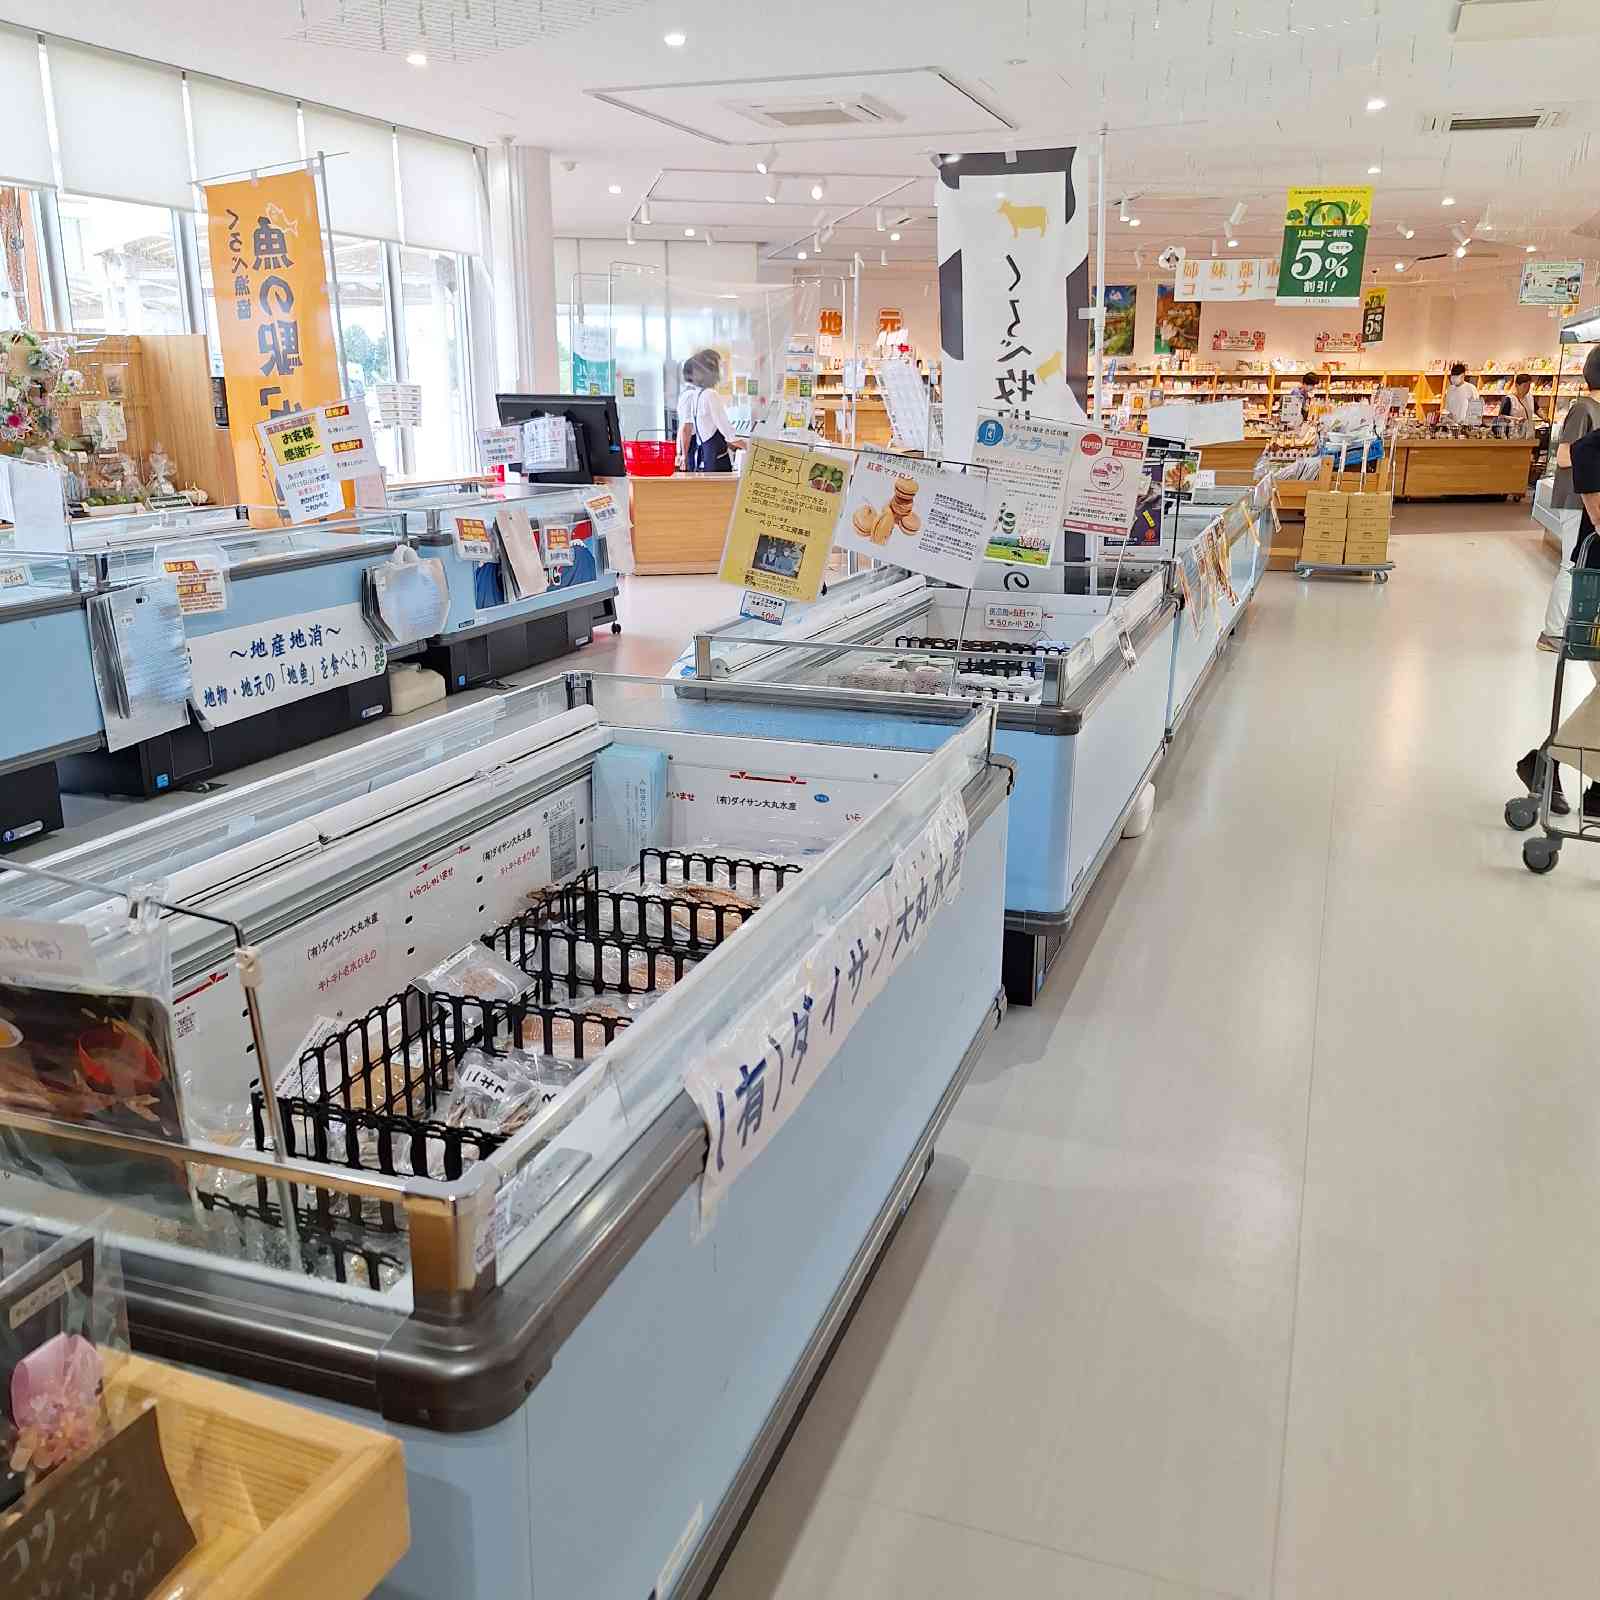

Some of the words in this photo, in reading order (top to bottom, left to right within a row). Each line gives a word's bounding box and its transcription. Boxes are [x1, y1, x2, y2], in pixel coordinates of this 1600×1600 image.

[1290, 239, 1349, 280] 5%
[281, 427, 315, 446] お客様
[307, 911, 379, 961] (有)ダイサン大丸水産
